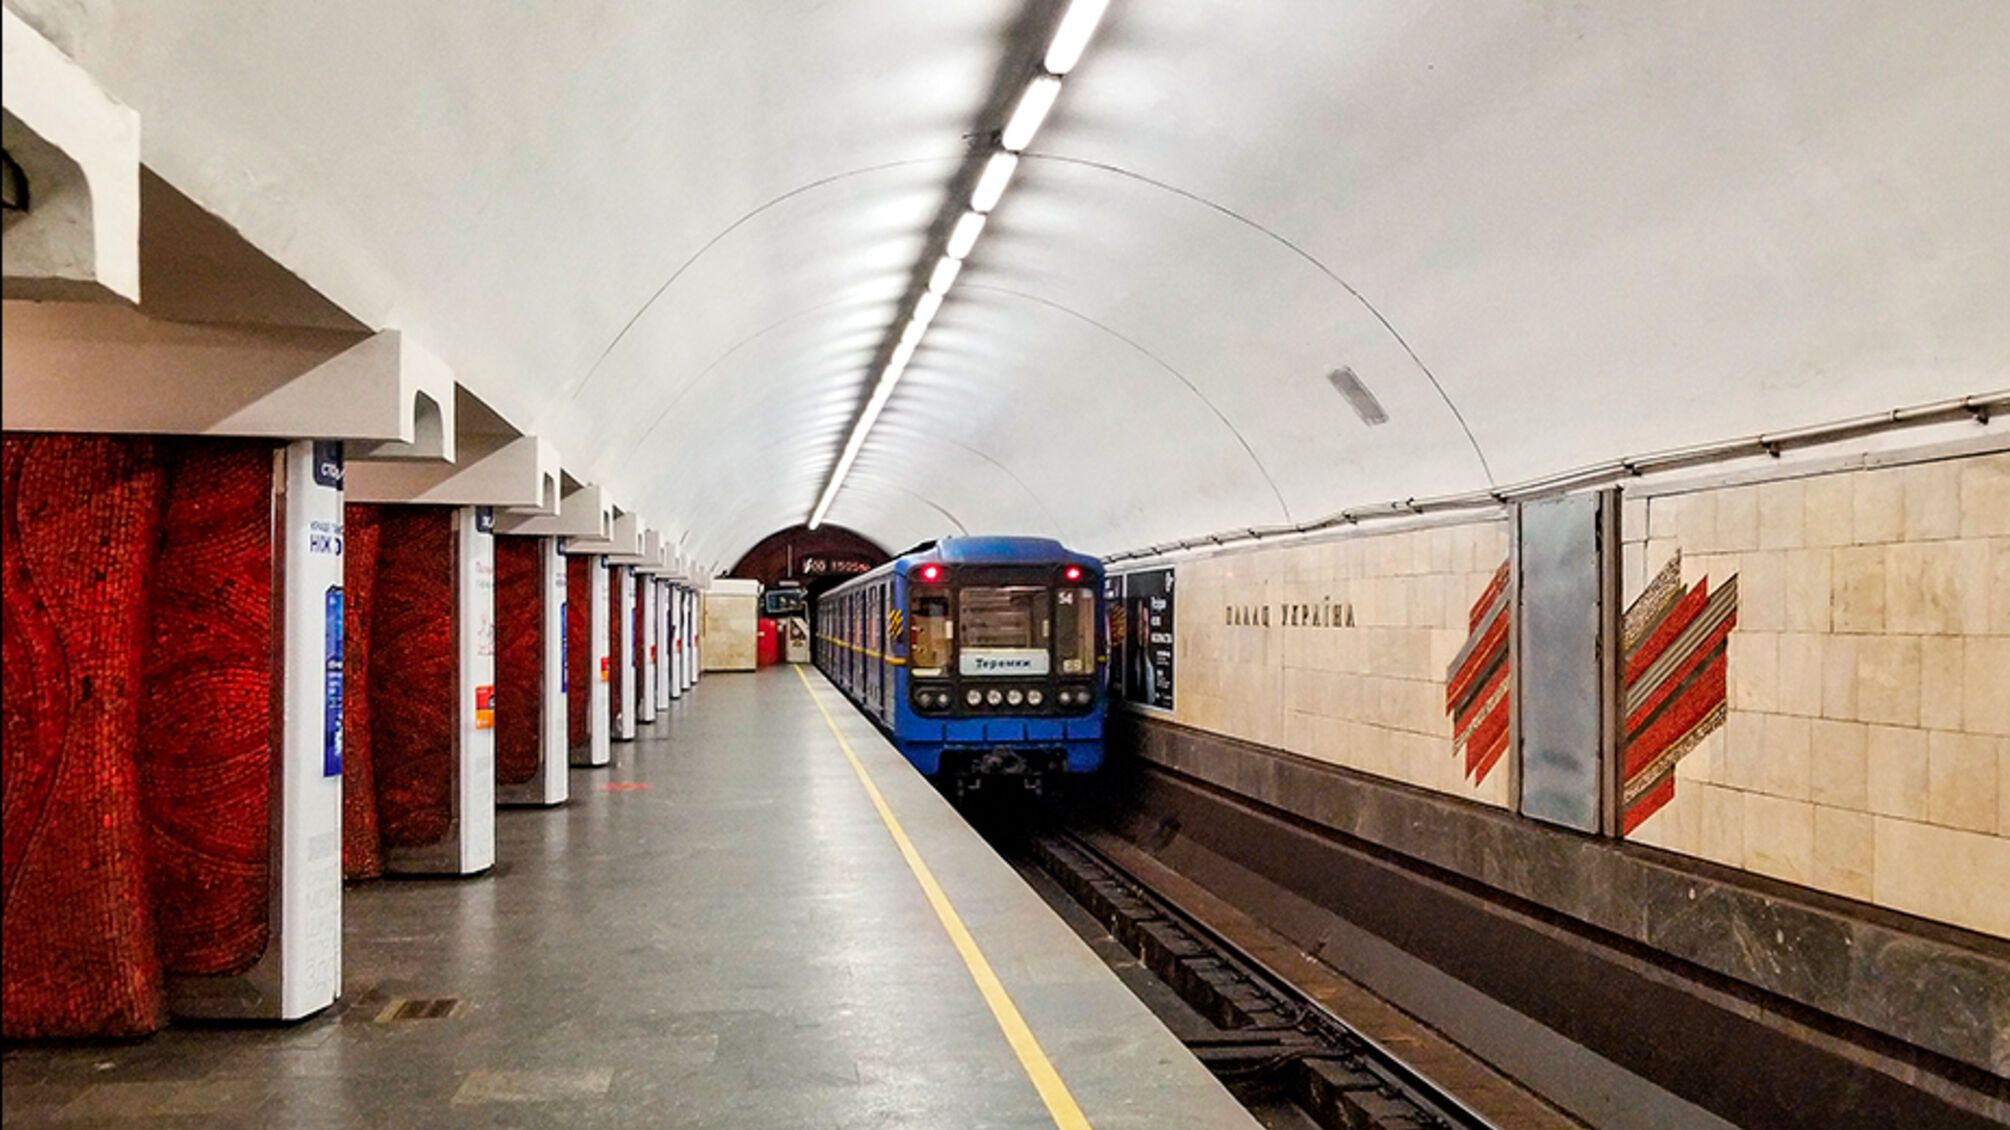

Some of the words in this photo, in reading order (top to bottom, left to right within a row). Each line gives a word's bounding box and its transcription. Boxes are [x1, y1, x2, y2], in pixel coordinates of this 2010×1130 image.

[1226, 604, 1270, 628] ПАЛАЦ
[1281, 595, 1355, 628] УКРАЇНА
[975, 657, 1031, 670] Теремки
